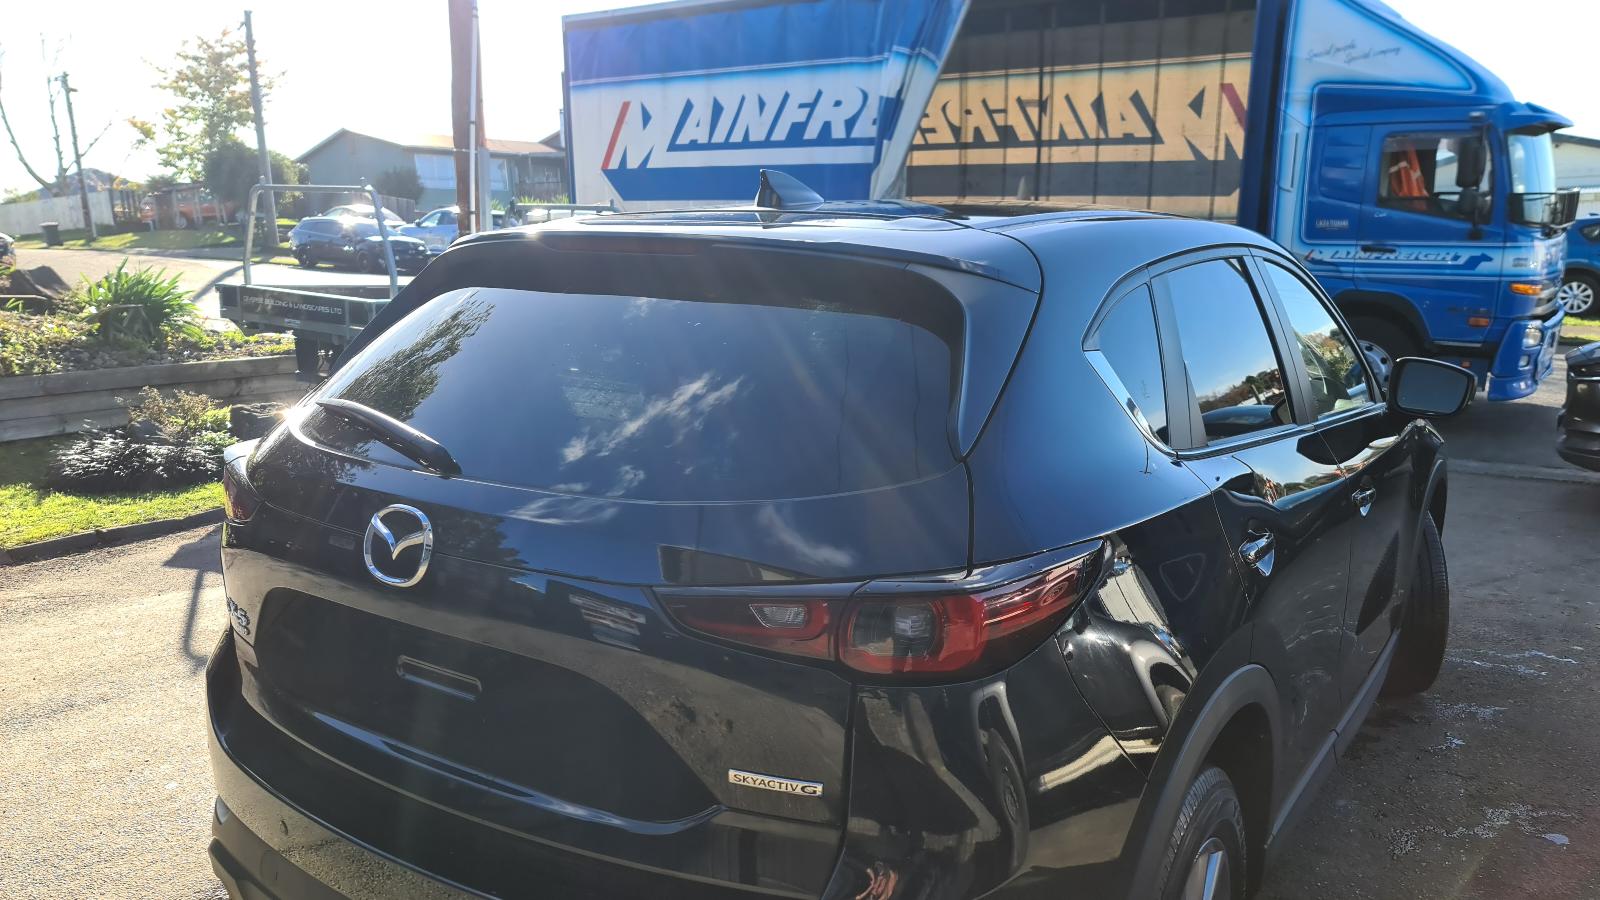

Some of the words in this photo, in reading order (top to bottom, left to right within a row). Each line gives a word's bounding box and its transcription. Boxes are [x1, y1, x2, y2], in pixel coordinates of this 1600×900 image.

[1305, 249, 1472, 266] MAINFREIGHT
[293, 303, 330, 313] LANDSCAPES
[330, 307, 342, 315] LTD
[733, 773, 799, 792] SKYACTIV
